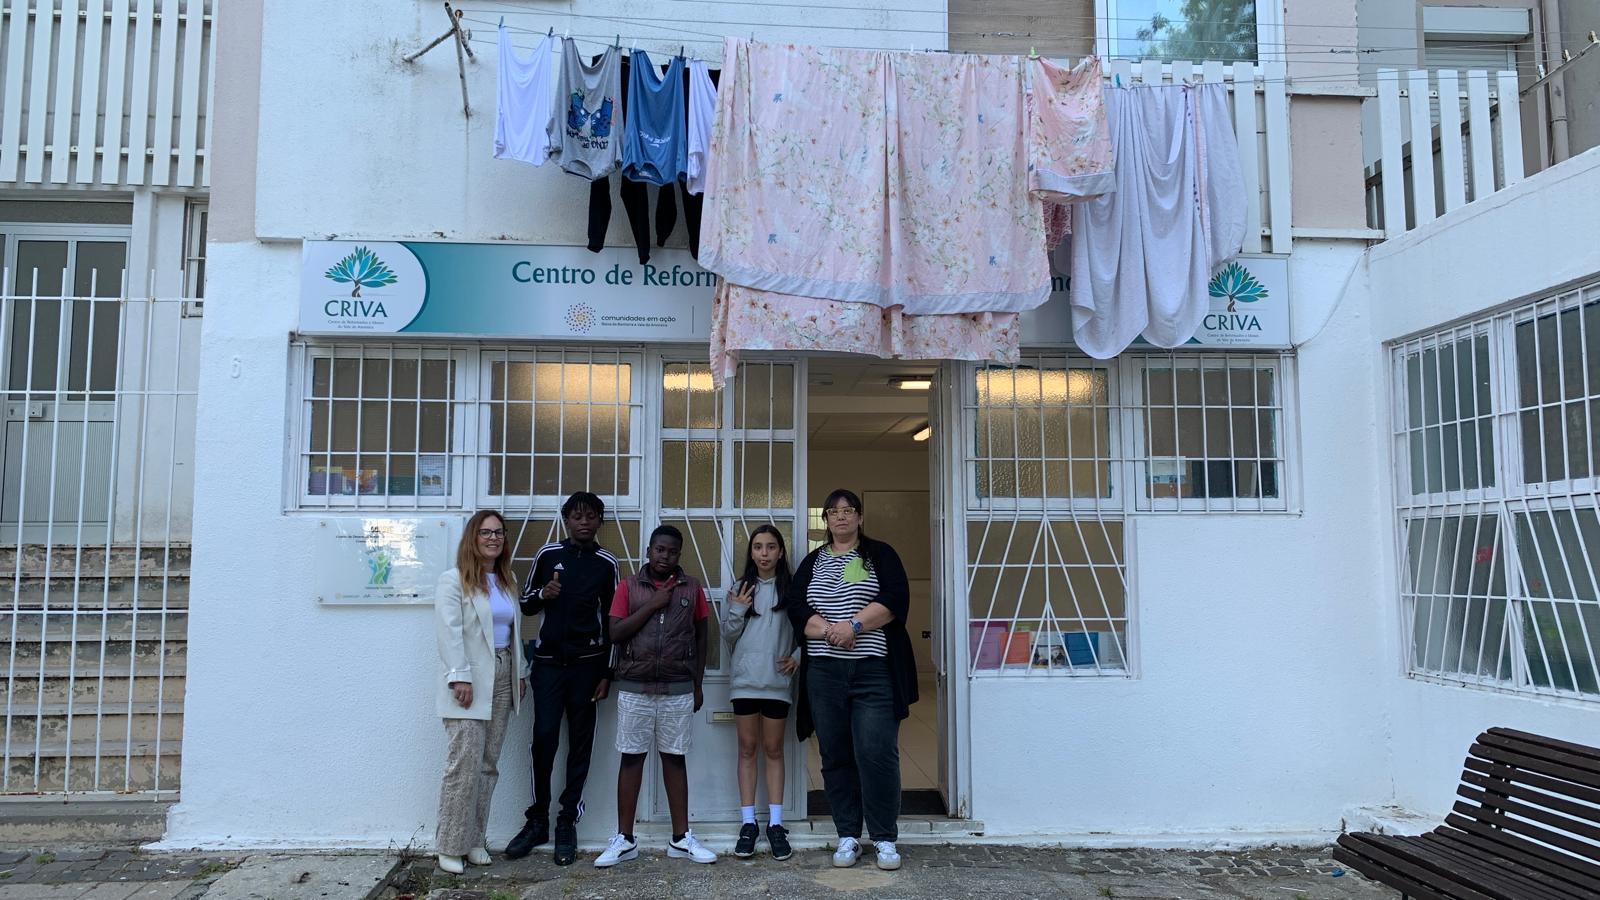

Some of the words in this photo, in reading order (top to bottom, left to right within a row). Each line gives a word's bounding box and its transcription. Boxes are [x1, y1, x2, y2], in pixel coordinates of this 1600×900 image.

[512, 261, 596, 284] Centro
[605, 264, 633, 285] de
[324, 299, 388, 318] CRIVA
[1203, 314, 1262, 331] CRIVA
